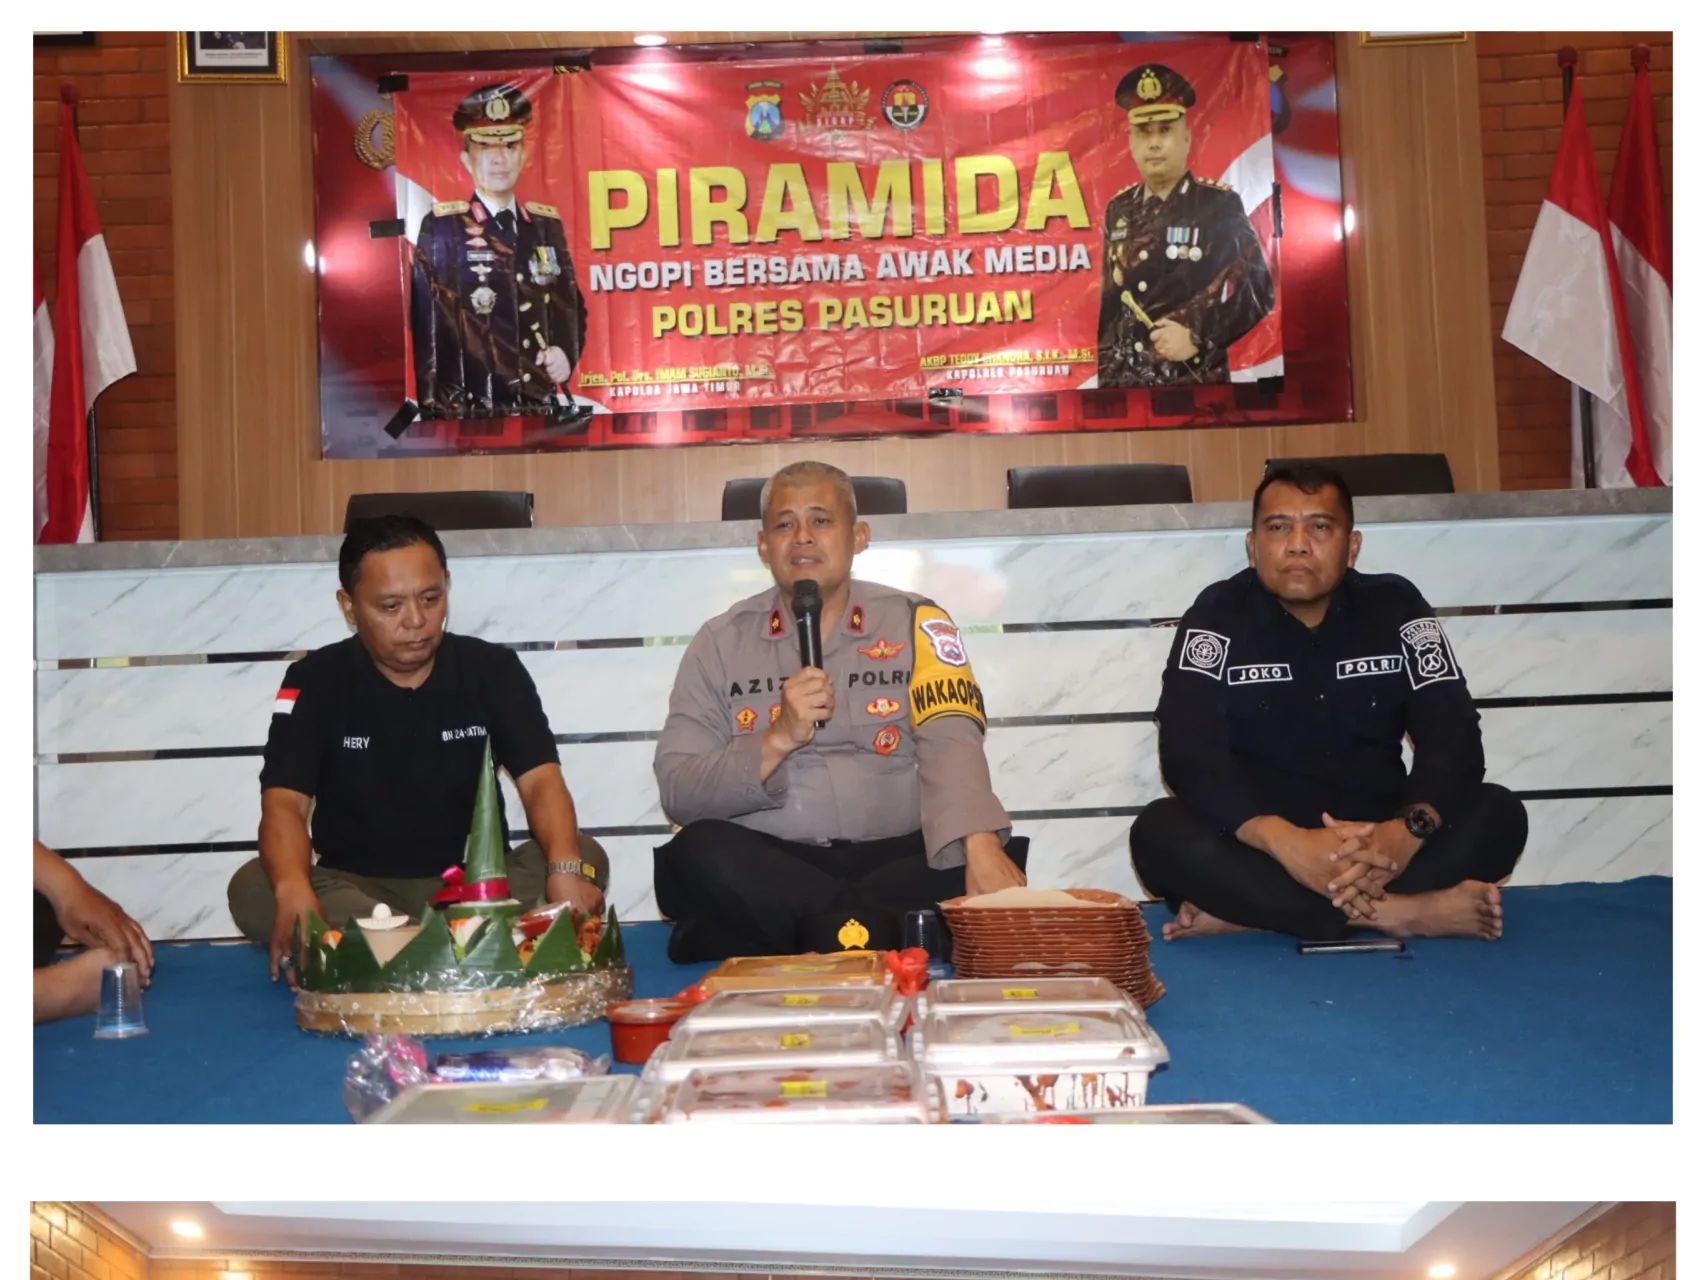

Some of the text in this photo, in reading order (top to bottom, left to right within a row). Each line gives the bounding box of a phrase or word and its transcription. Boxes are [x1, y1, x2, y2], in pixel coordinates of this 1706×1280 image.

[588, 151, 1092, 250] PIRAMIDA
[589, 243, 1091, 292] NGOPI BERSAMA AWAK MEDIA
[652, 290, 1033, 339] POLRES PASURUAN
[920, 355, 947, 368] AKBP
[950, 352, 979, 365] TEDDY
[655, 367, 686, 380] IMAM
[946, 365, 1071, 380] KAPOLRES PASURUAN
[609, 381, 741, 398] KAPOLDA JAWA TIMUR
[1239, 666, 1283, 681] JOKO
[1344, 658, 1396, 675] POLRI
[730, 676, 790, 697] AZIZ
[848, 671, 911, 688] POLRI
[342, 736, 370, 750] HERY
